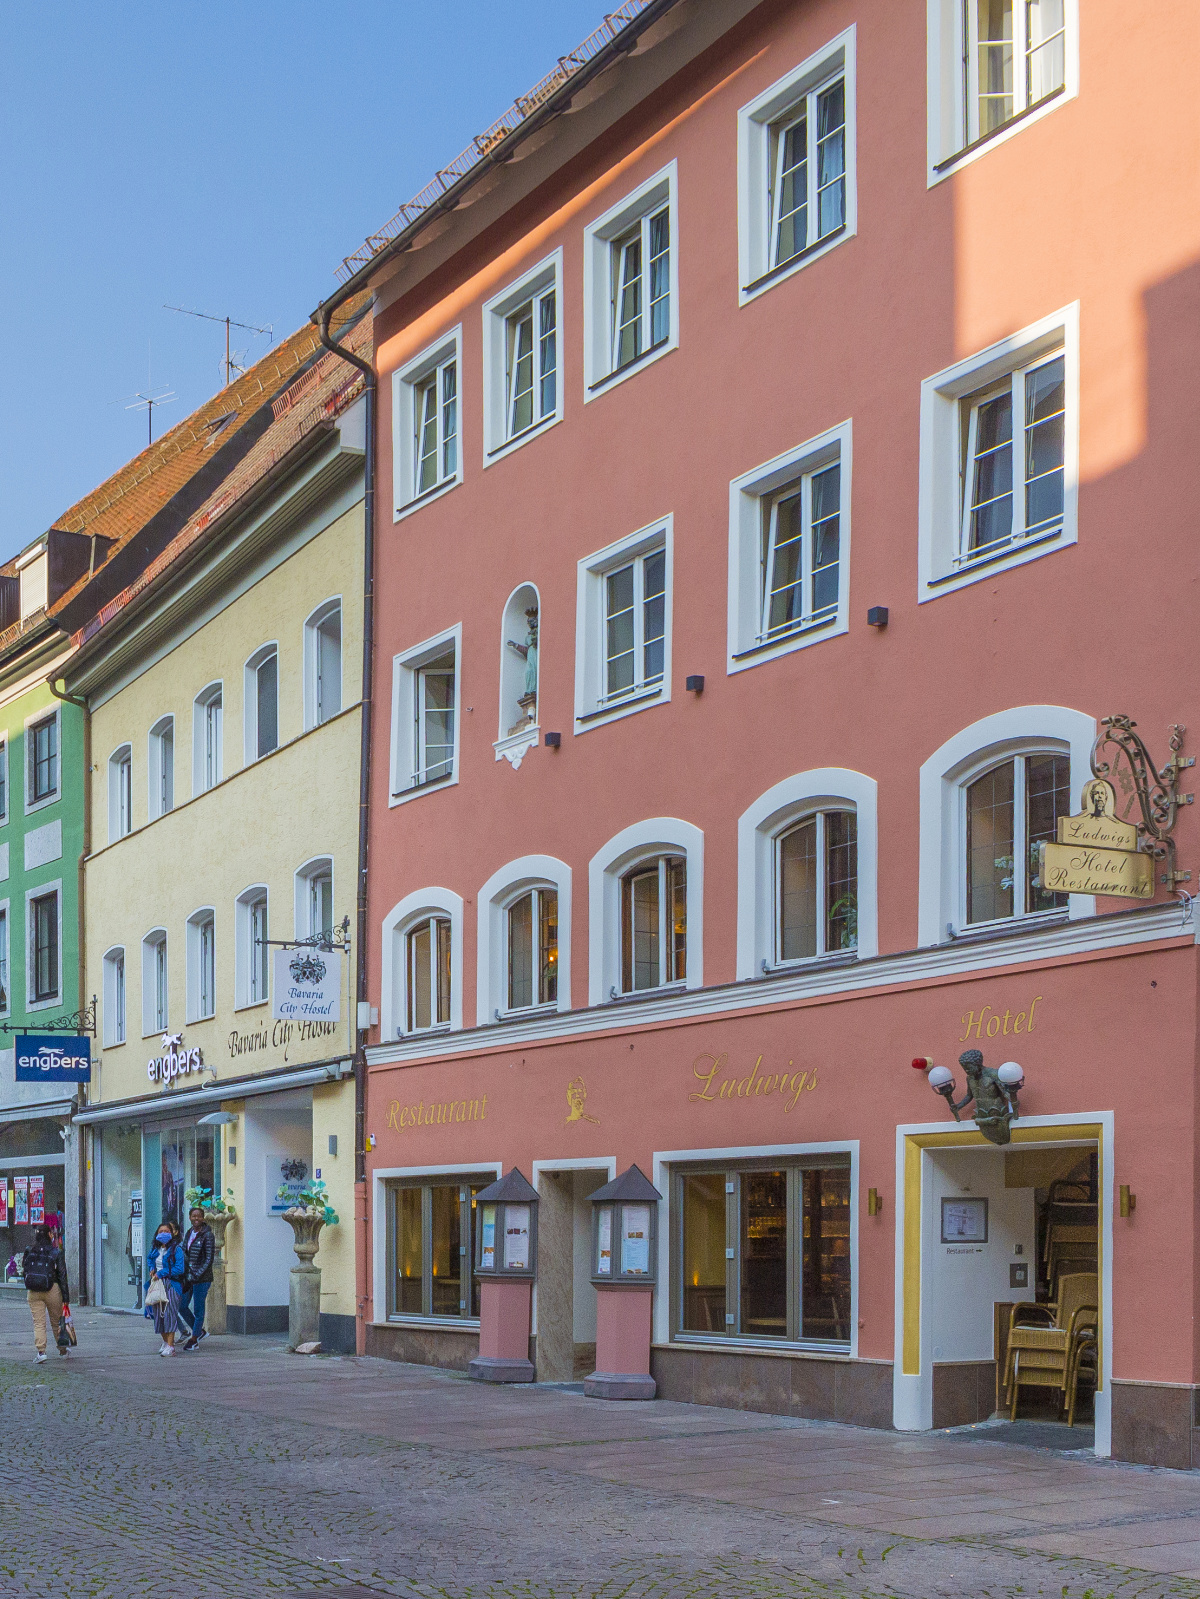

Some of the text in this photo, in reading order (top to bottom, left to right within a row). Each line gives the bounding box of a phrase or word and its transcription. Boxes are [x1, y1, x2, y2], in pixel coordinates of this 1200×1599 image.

[1068, 821, 1131, 847] Ludwigs
[1070, 851, 1128, 874] Hotel
[1048, 866, 1149, 895] Restaurant
[287, 987, 324, 1000] Bavaria
[280, 1000, 335, 1019] City Hostel
[958, 996, 1043, 1042] Hotel
[228, 1020, 268, 1058] Bavaria
[272, 1019, 294, 1062] City
[18, 1053, 89, 1071] engbers
[147, 1045, 201, 1085] engbers
[688, 1052, 819, 1113] Ludwigs
[385, 1094, 488, 1133] Restaurant
